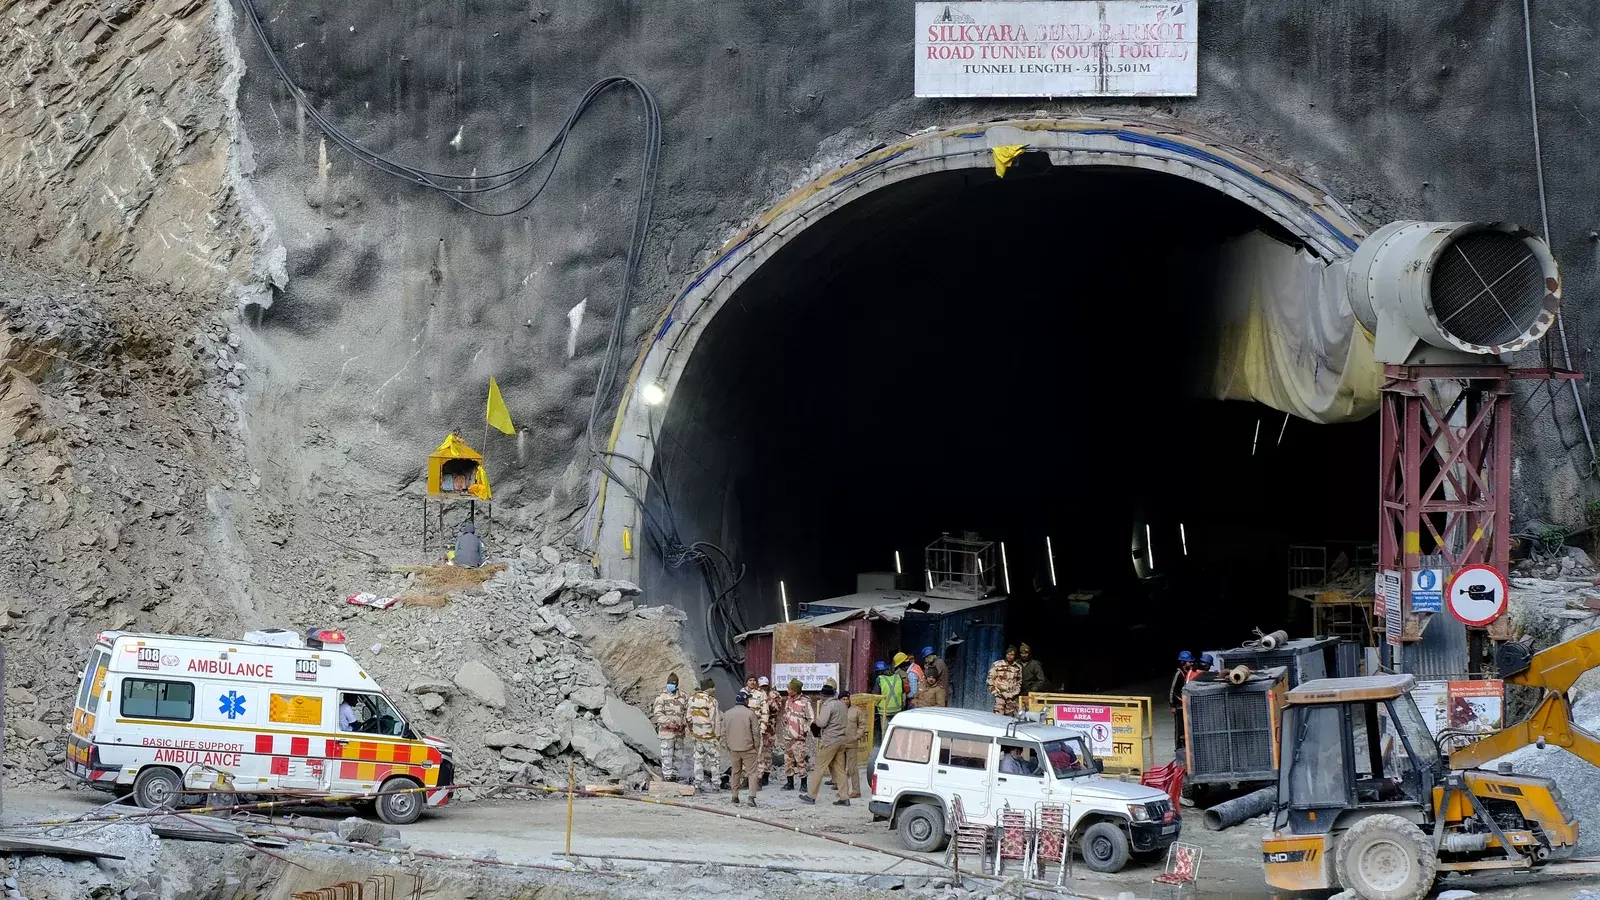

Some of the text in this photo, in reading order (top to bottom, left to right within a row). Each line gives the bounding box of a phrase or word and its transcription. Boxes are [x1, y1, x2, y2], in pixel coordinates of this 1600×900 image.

[928, 24, 1029, 42] SILKYARA
[927, 44, 1189, 62] ROAD TUNNEL (SOUTH PORTAL)
[963, 64, 1016, 74] TUNNEL
[1019, 63, 1073, 74] LENGTH
[1084, 63, 1151, 73] 450.501M
[139, 648, 159, 662] 108
[187, 658, 274, 678] AMBULANCE
[297, 660, 317, 673] 108
[142, 737, 244, 752] BASIC LIFE SUPPORT
[154, 748, 242, 767] AMBULANCE
[1270, 853, 1288, 862] HD
